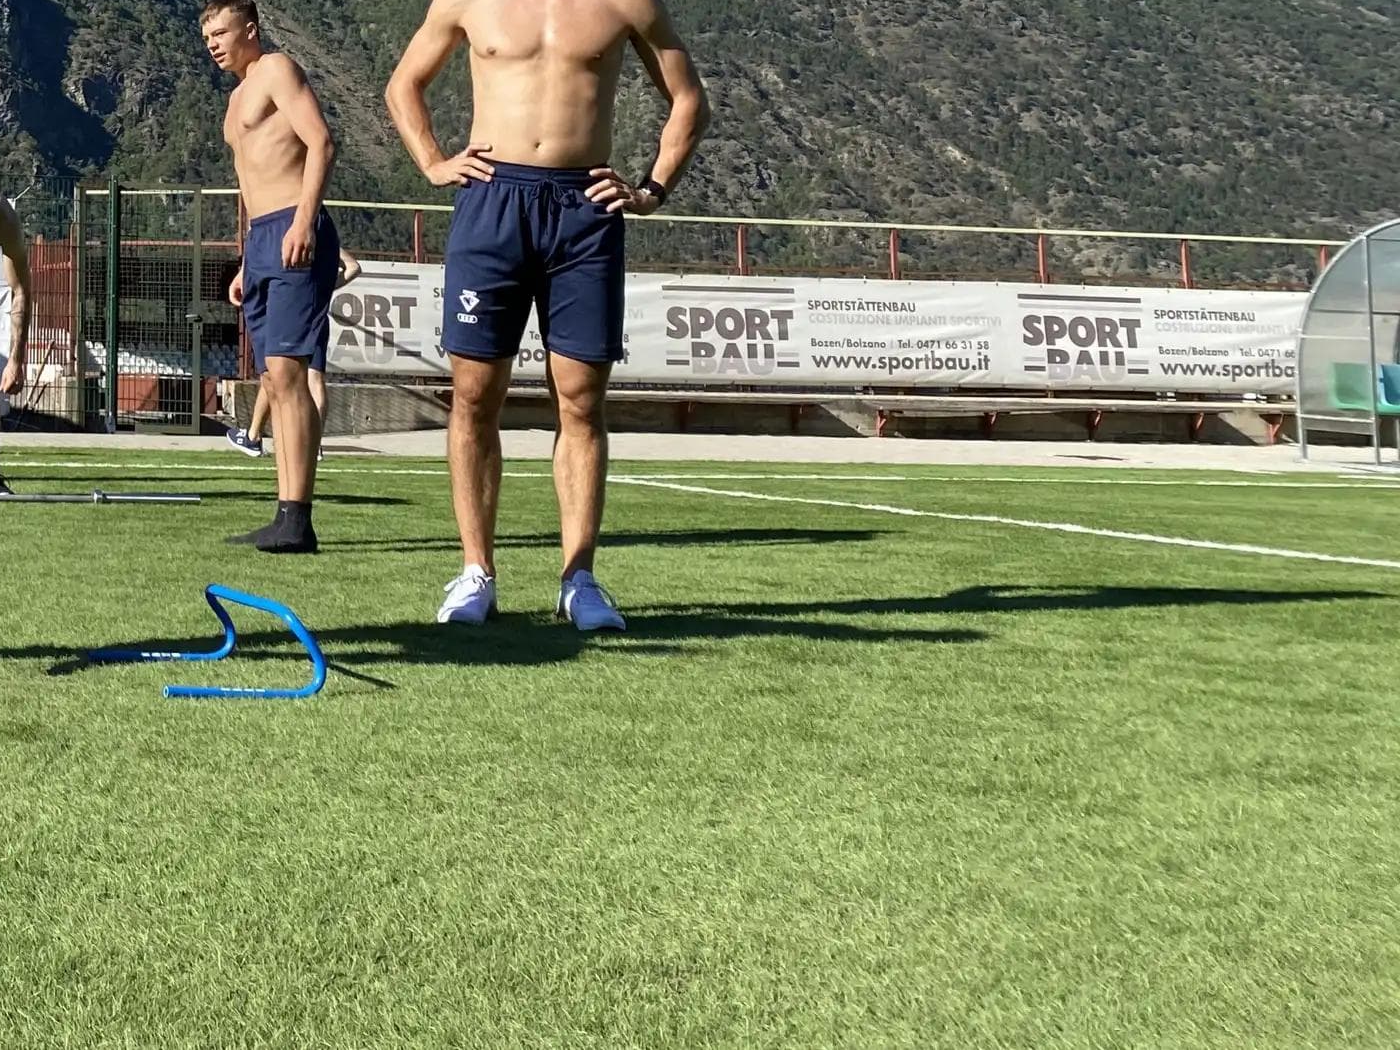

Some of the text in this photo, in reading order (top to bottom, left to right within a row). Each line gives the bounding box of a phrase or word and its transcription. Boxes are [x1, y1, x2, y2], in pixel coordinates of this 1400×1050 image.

[330, 293, 418, 329] ORT
[807, 298, 916, 313] SPORTSTÄTTENBAU
[1153, 307, 1256, 322] SPORTSTÄTTENBAU
[666, 306, 794, 341] SPORT
[808, 313, 895, 326] COSTRUZIONE
[895, 315, 946, 326] IMPIANTI
[1022, 314, 1142, 349] SPORT
[330, 329, 395, 364] AU
[810, 337, 990, 350] Bozen/Bolzano Tel. 0471 66 31 58
[1158, 345, 1229, 357] Bozen/Bolzano
[1257, 348, 1281, 358] 0471
[691, 342, 775, 375] BAU
[811, 350, 991, 375] www.sportbau.it
[1046, 348, 1126, 382] BAU
[1160, 359, 1296, 382] www.sportba
